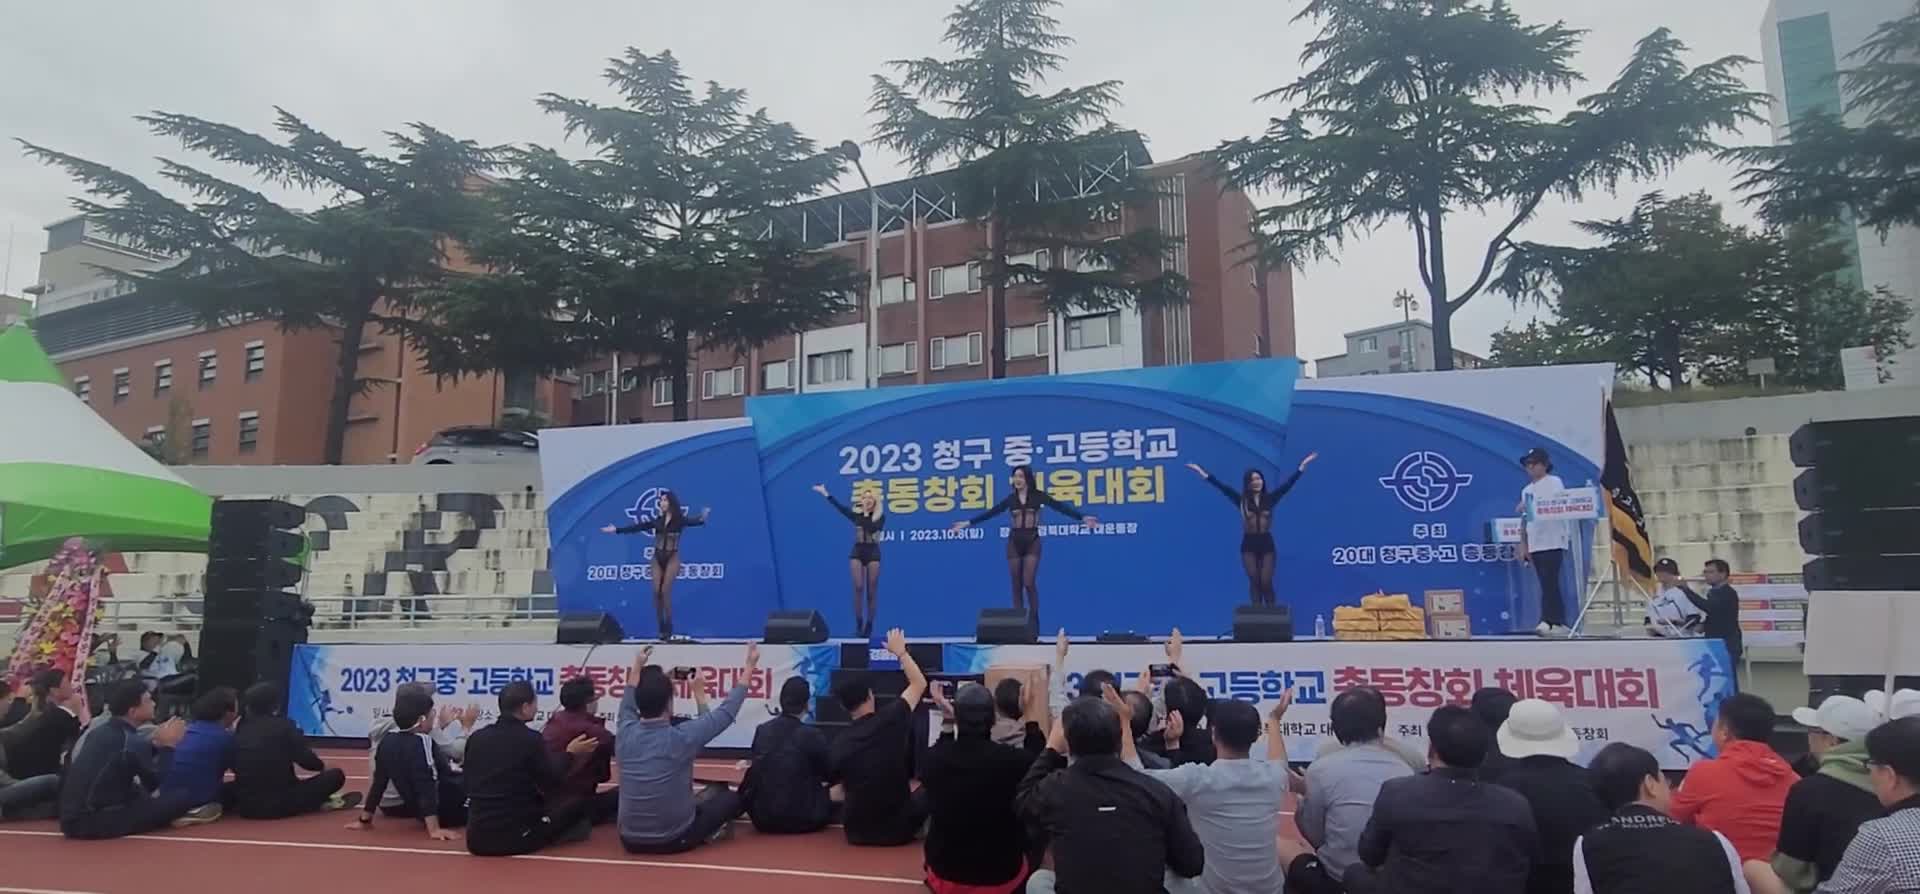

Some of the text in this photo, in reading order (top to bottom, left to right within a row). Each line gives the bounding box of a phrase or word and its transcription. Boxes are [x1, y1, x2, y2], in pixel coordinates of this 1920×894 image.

[839, 428, 1179, 475] 2023 청구 중·고등학교
[1333, 543, 1518, 565] 20대 청구중·고 총동창
[587, 566, 618, 580] 20대
[341, 668, 390, 692] 2023
[1494, 667, 1660, 709] 체육대회
